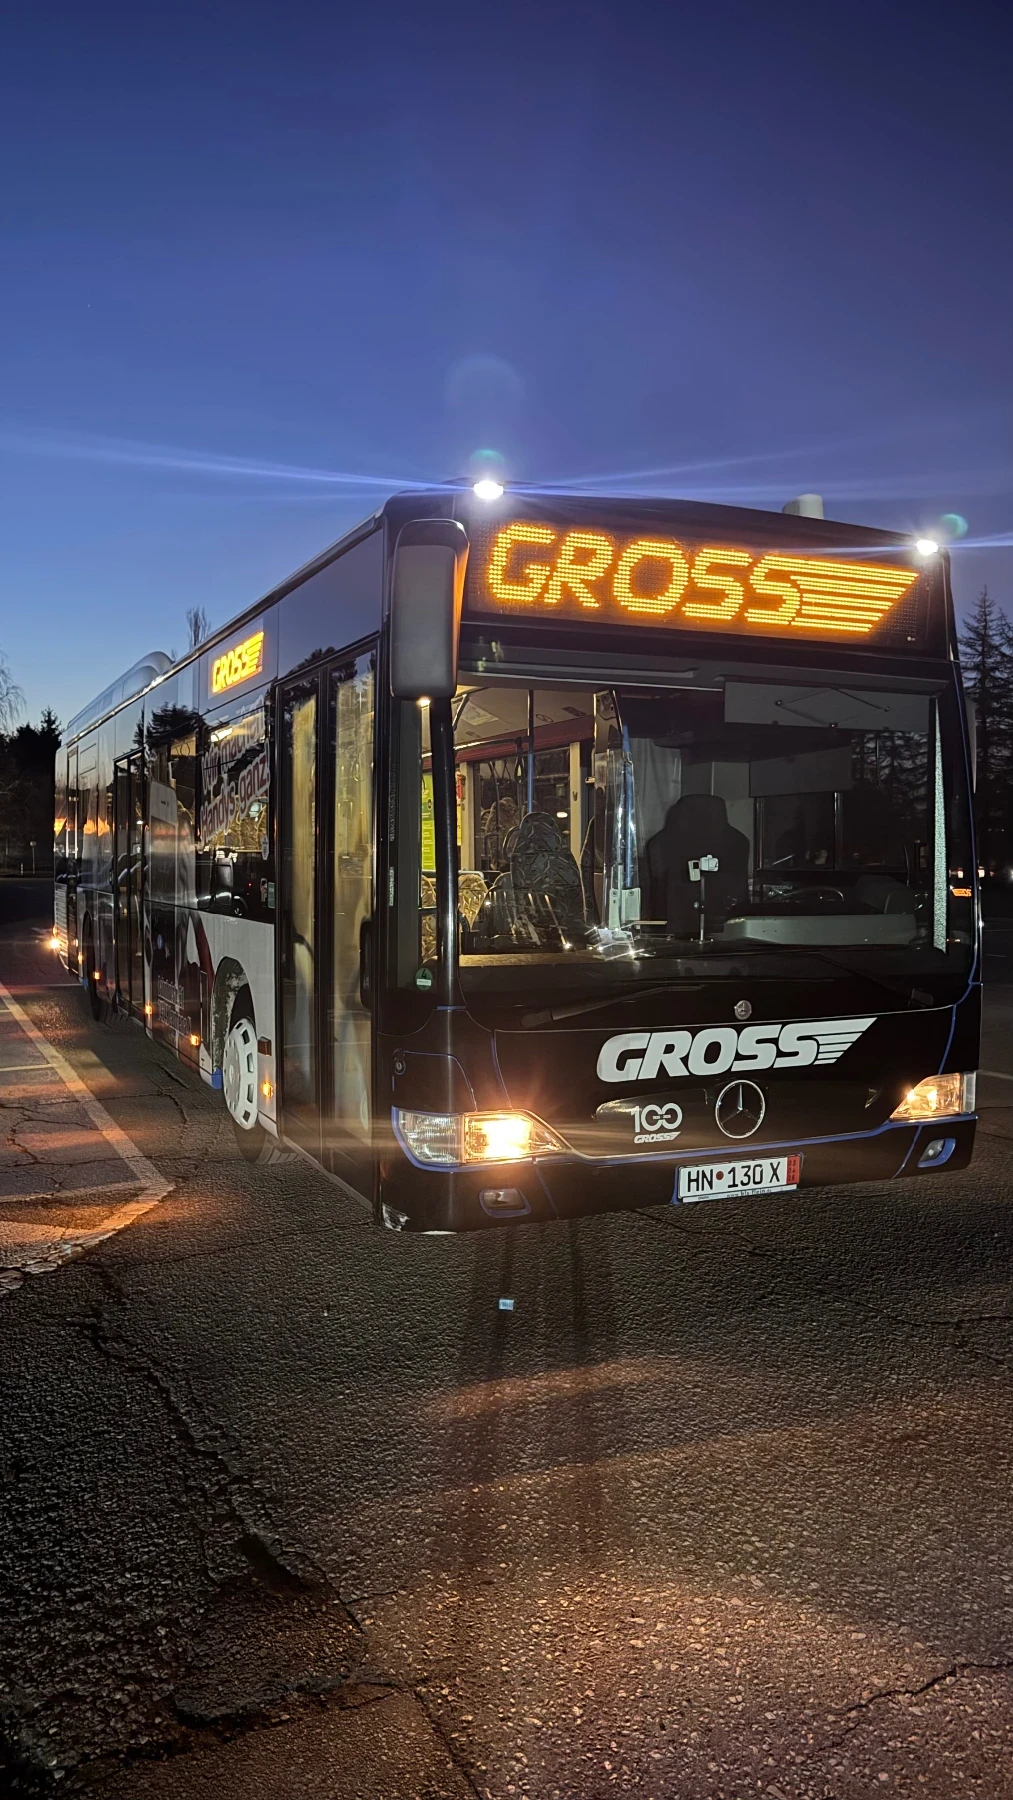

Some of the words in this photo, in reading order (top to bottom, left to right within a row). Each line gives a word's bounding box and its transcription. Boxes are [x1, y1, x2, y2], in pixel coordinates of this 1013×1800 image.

[487, 523, 919, 633] GROSS
[212, 631, 264, 693] GROSS
[421, 968, 427, 979] 4
[596, 1017, 878, 1083] GROSS
[631, 1102, 683, 1133] 100
[634, 1131, 682, 1144] GROSS
[687, 1169, 714, 1192] HN
[727, 1164, 763, 1188] 130
[769, 1161, 781, 1183] X
